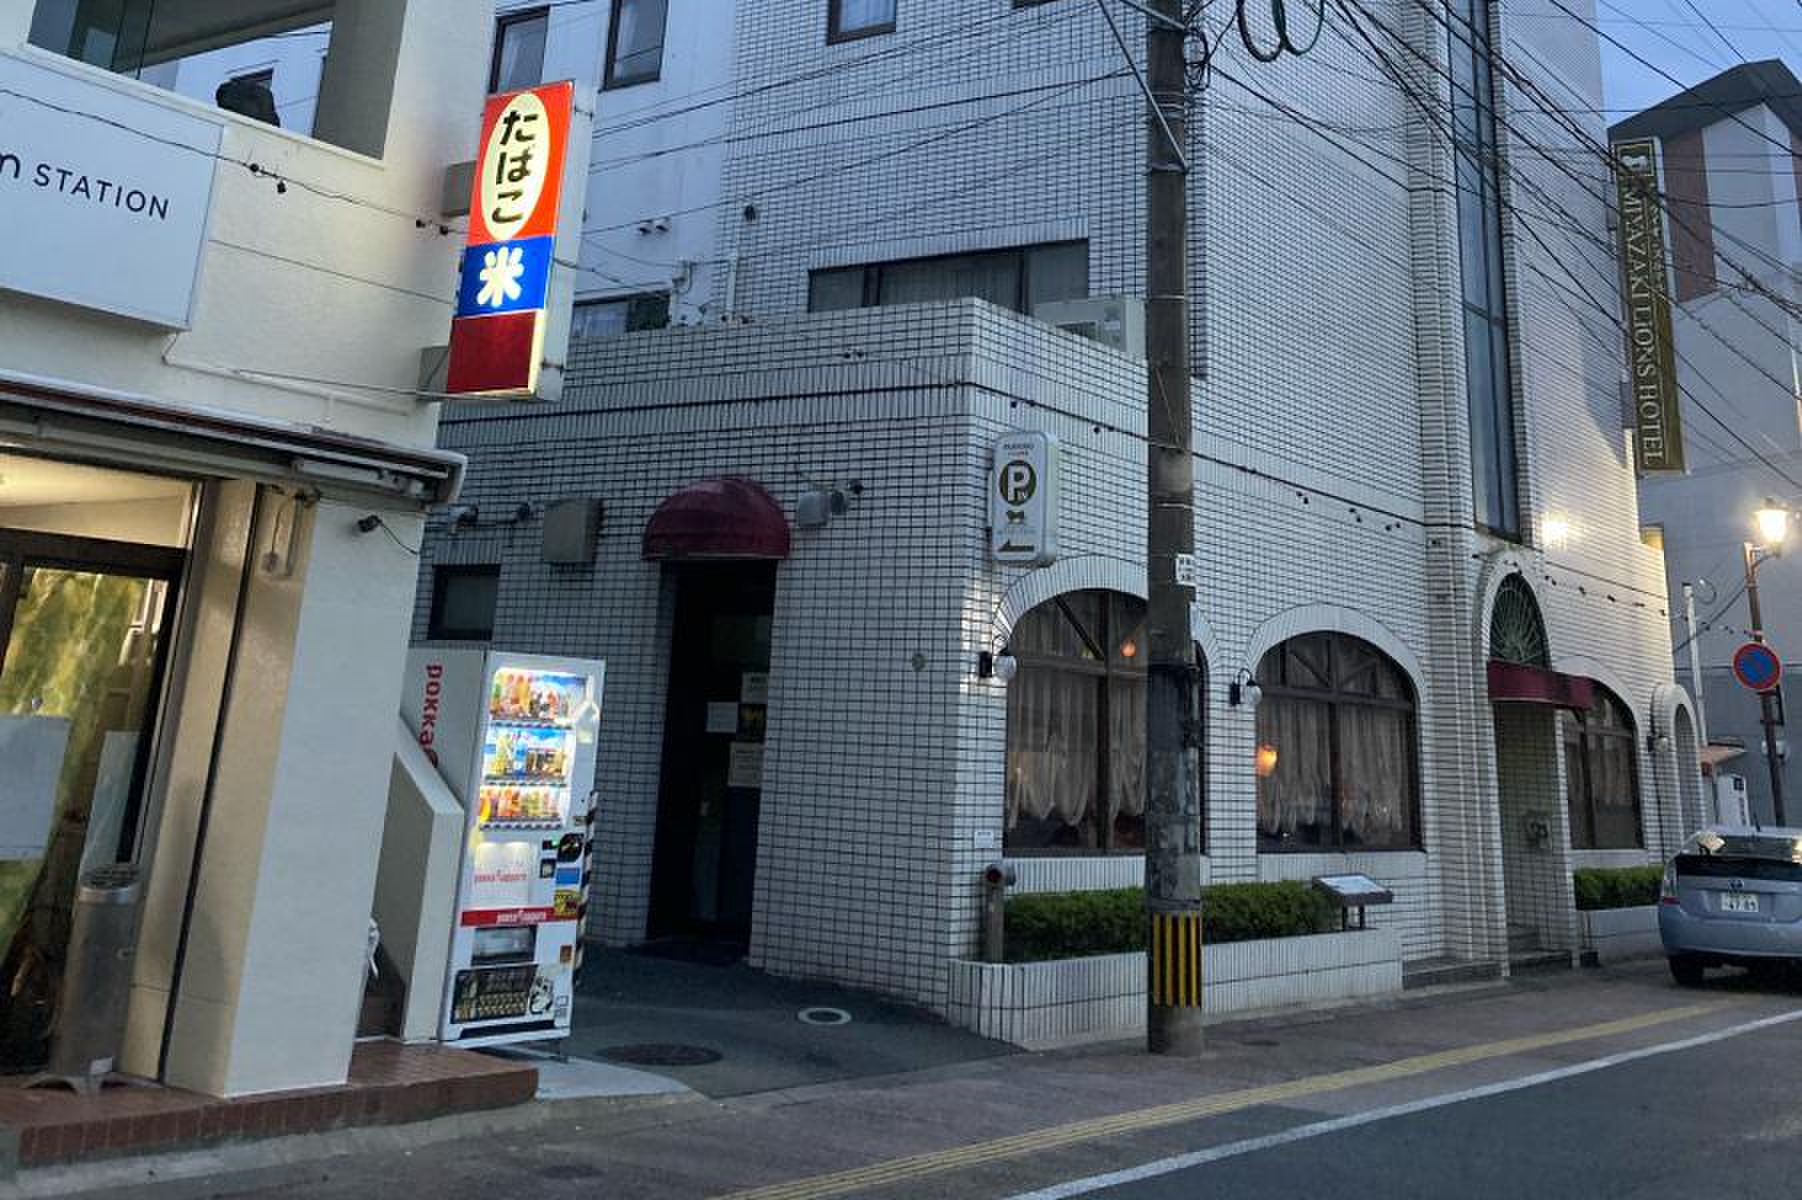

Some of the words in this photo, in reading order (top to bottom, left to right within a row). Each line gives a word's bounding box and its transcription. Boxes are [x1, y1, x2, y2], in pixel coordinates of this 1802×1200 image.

[33, 163, 169, 220] STATION
[477, 246, 525, 308] 米
[1633, 306, 1656, 377] LIONS
[1639, 385, 1664, 465] HOTEL
[1007, 464, 1031, 502] P
